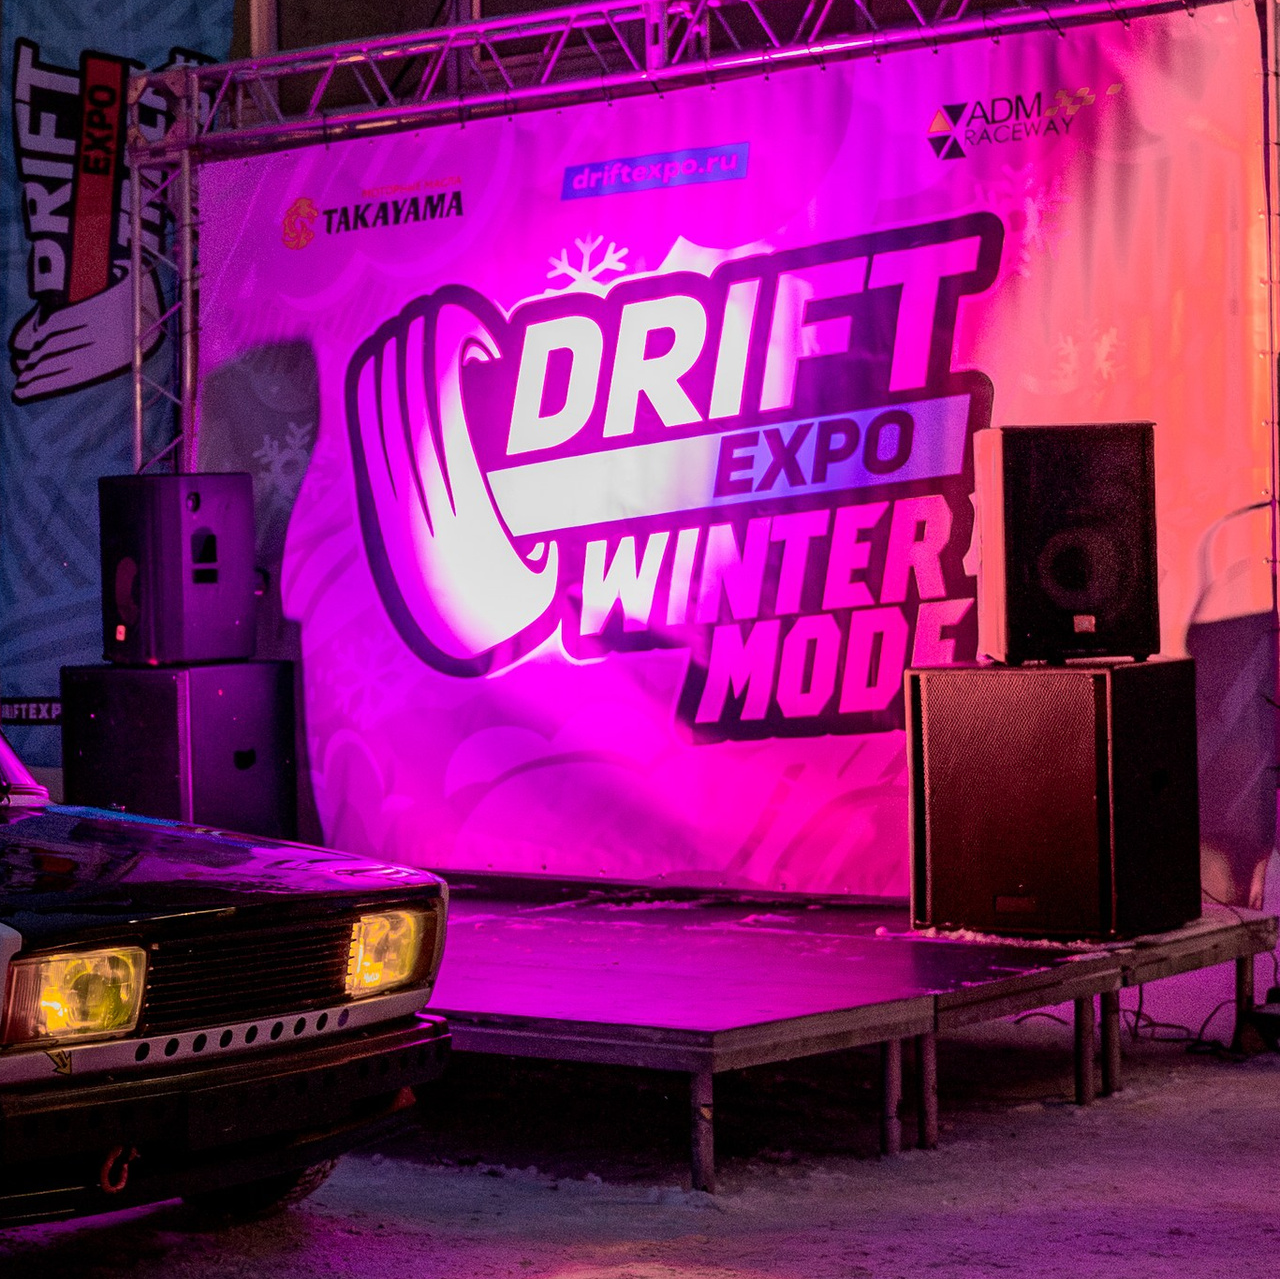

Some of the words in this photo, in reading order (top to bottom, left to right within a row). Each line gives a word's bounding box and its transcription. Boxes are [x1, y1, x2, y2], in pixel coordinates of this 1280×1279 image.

[82, 84, 117, 176] EXPO
[964, 117, 1074, 146] RACEWAY
[966, 91, 1042, 128] ADM
[15, 44, 81, 293] DRIFT
[322, 190, 464, 235] TAKAYAMA
[572, 151, 737, 191] driftexpo.ru
[505, 235, 983, 456] DRIFT
[713, 409, 914, 499] EXPO
[579, 493, 954, 637] WINTER
